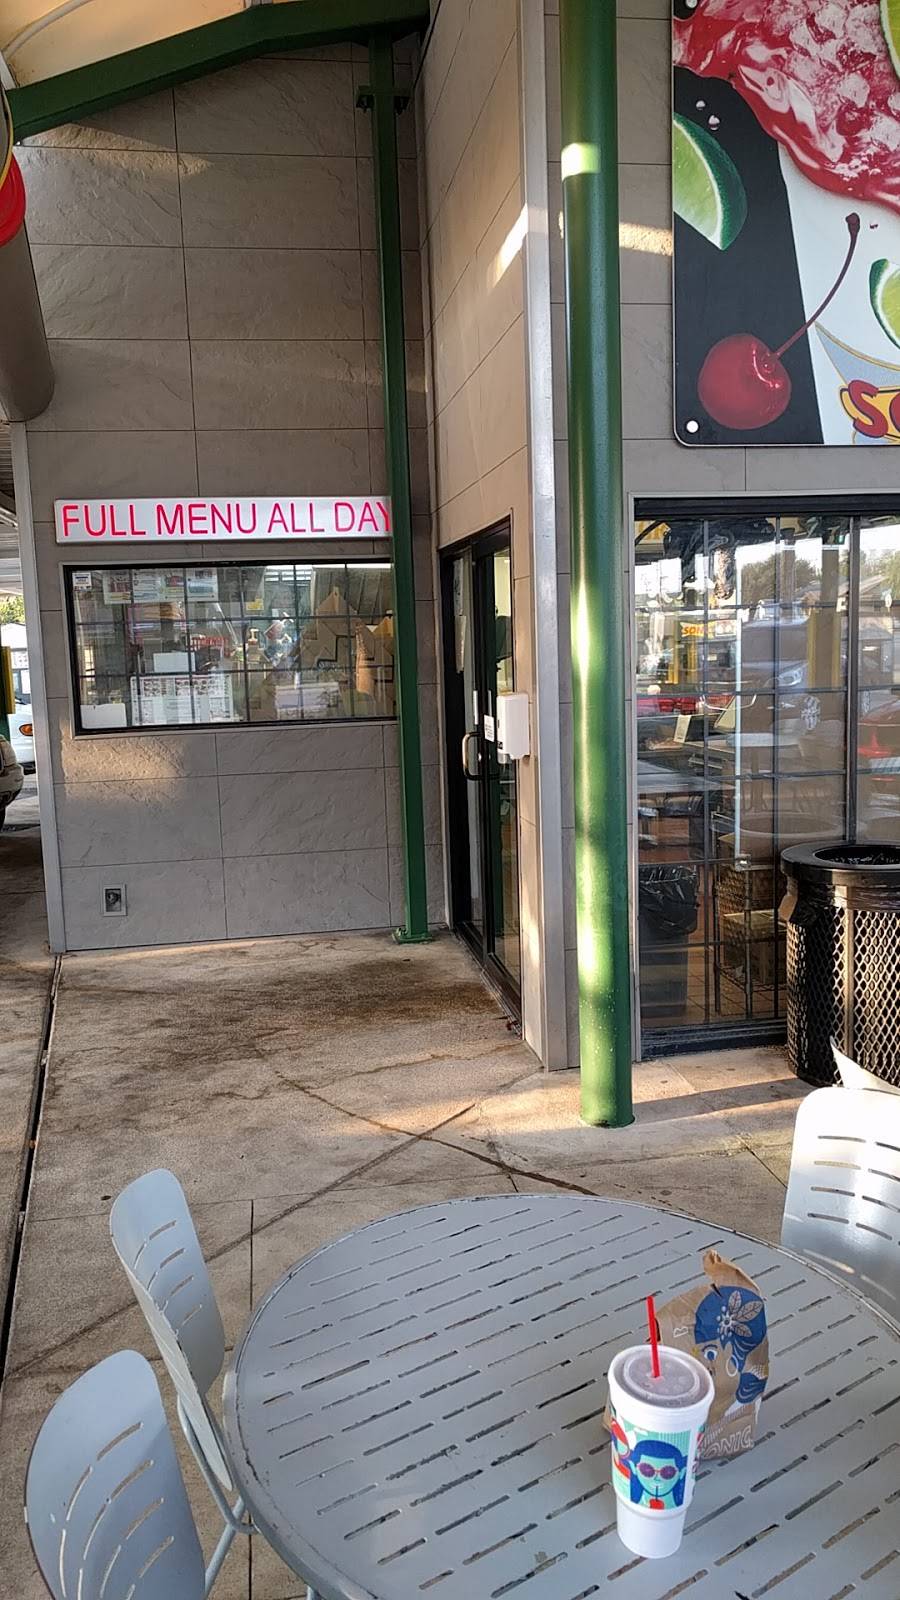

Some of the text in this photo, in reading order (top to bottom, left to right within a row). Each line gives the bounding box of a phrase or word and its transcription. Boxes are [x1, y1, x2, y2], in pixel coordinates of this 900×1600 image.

[62, 504, 145, 537] FULL
[156, 503, 256, 534] MENU
[268, 502, 324, 532] ALL
